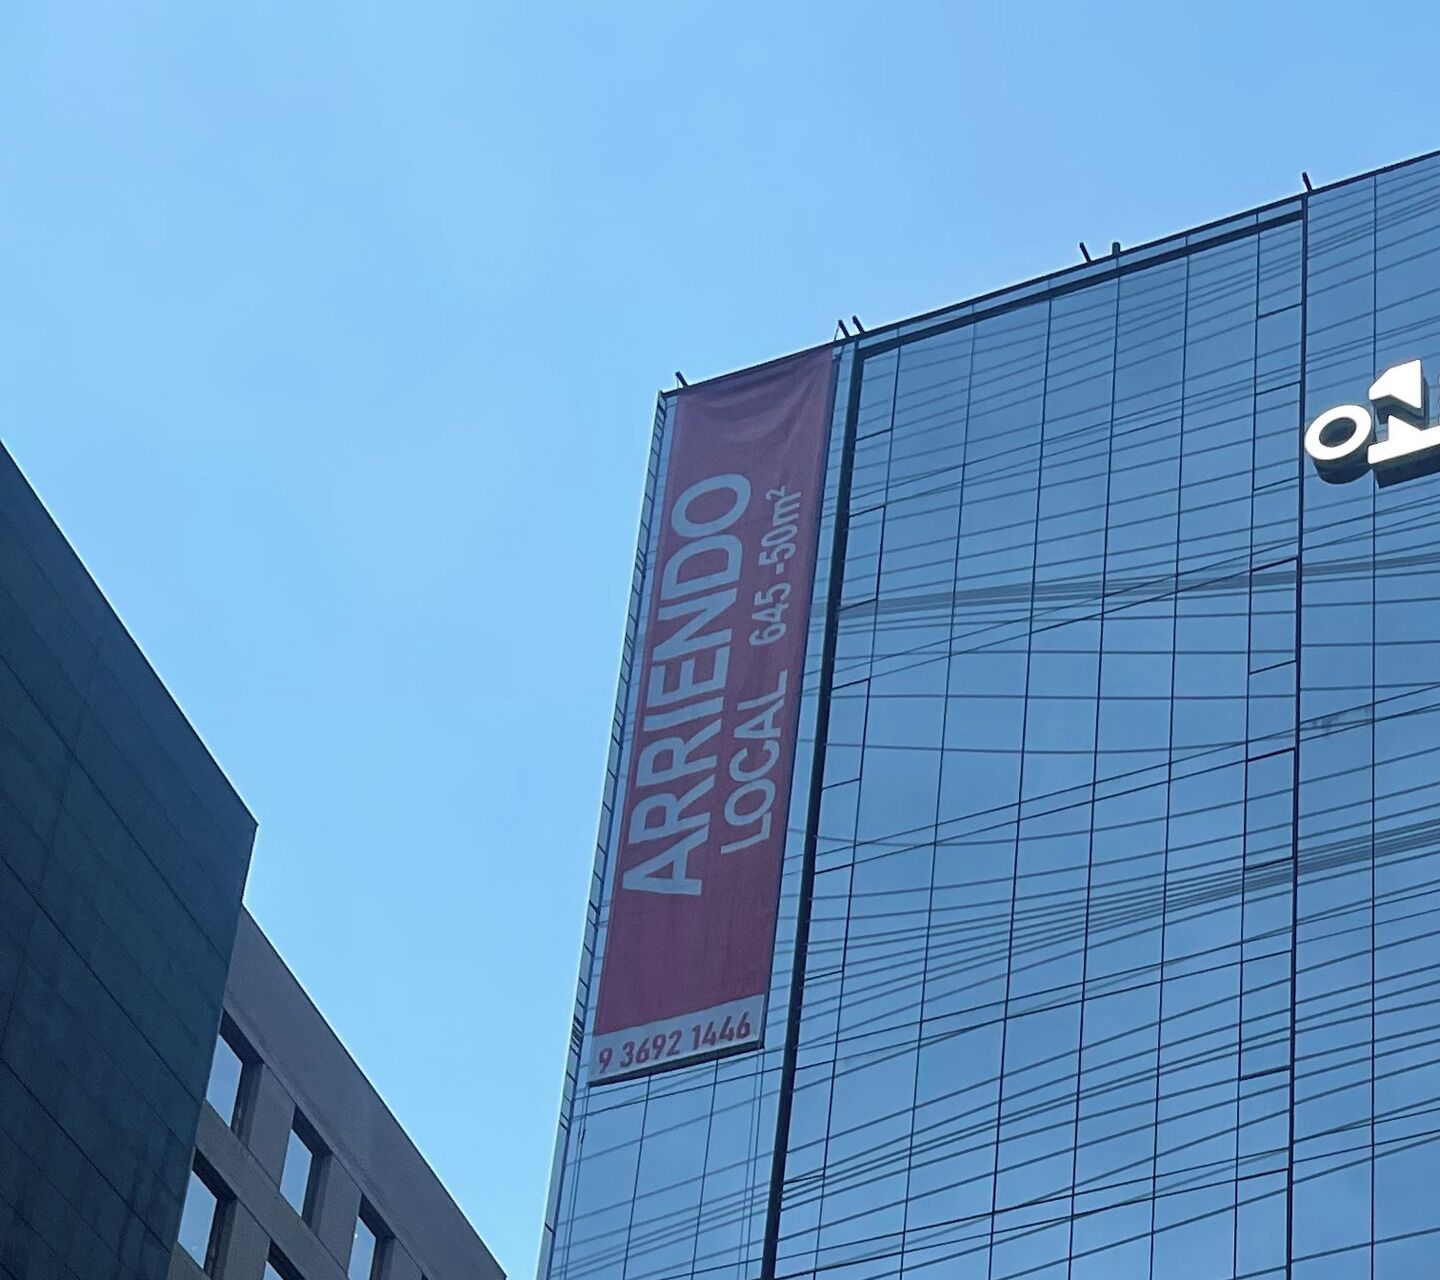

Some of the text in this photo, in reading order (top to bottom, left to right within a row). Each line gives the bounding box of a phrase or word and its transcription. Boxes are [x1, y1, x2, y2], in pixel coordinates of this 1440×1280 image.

[622, 473, 751, 897] ARRIENDO
[721, 671, 788, 856] LOCAL
[598, 1011, 751, 1074] 9 3692 1446
